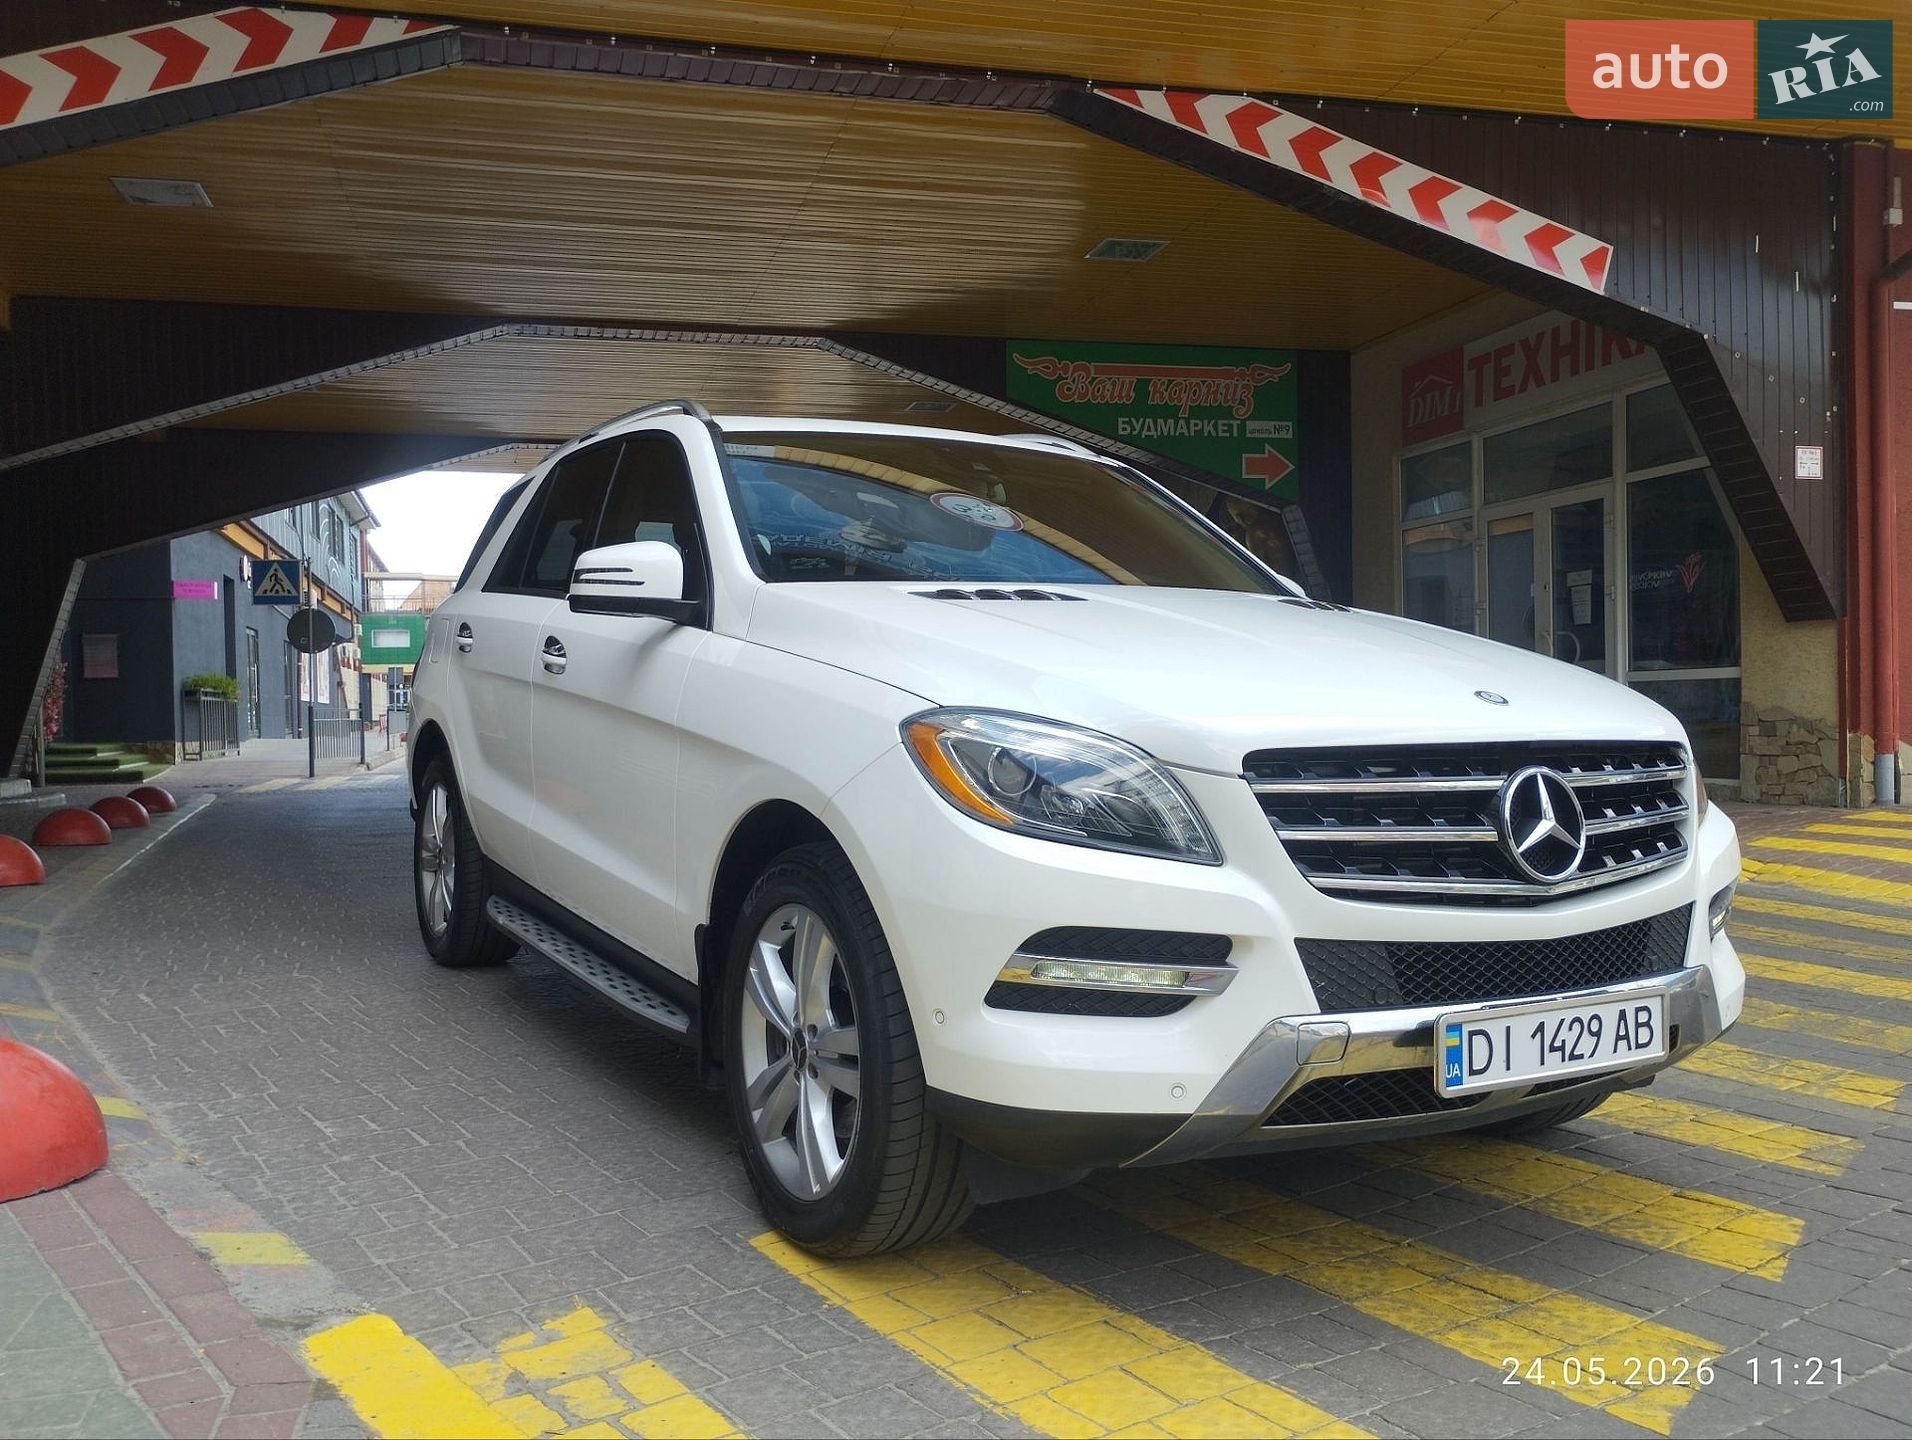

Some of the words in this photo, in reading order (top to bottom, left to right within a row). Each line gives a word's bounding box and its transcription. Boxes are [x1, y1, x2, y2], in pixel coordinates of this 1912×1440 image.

[1056, 362, 1136, 404] Ваш
[1148, 377, 1254, 419] карниз
[1467, 319, 1647, 408] ТЕХНІК
[1118, 417, 1240, 438] БУДМАРКЕТ
[1468, 1025, 1511, 1076] DI
[1530, 1013, 1603, 1066] 1429
[1613, 1005, 1654, 1054] AB
[1445, 1063, 1461, 1078] UA
